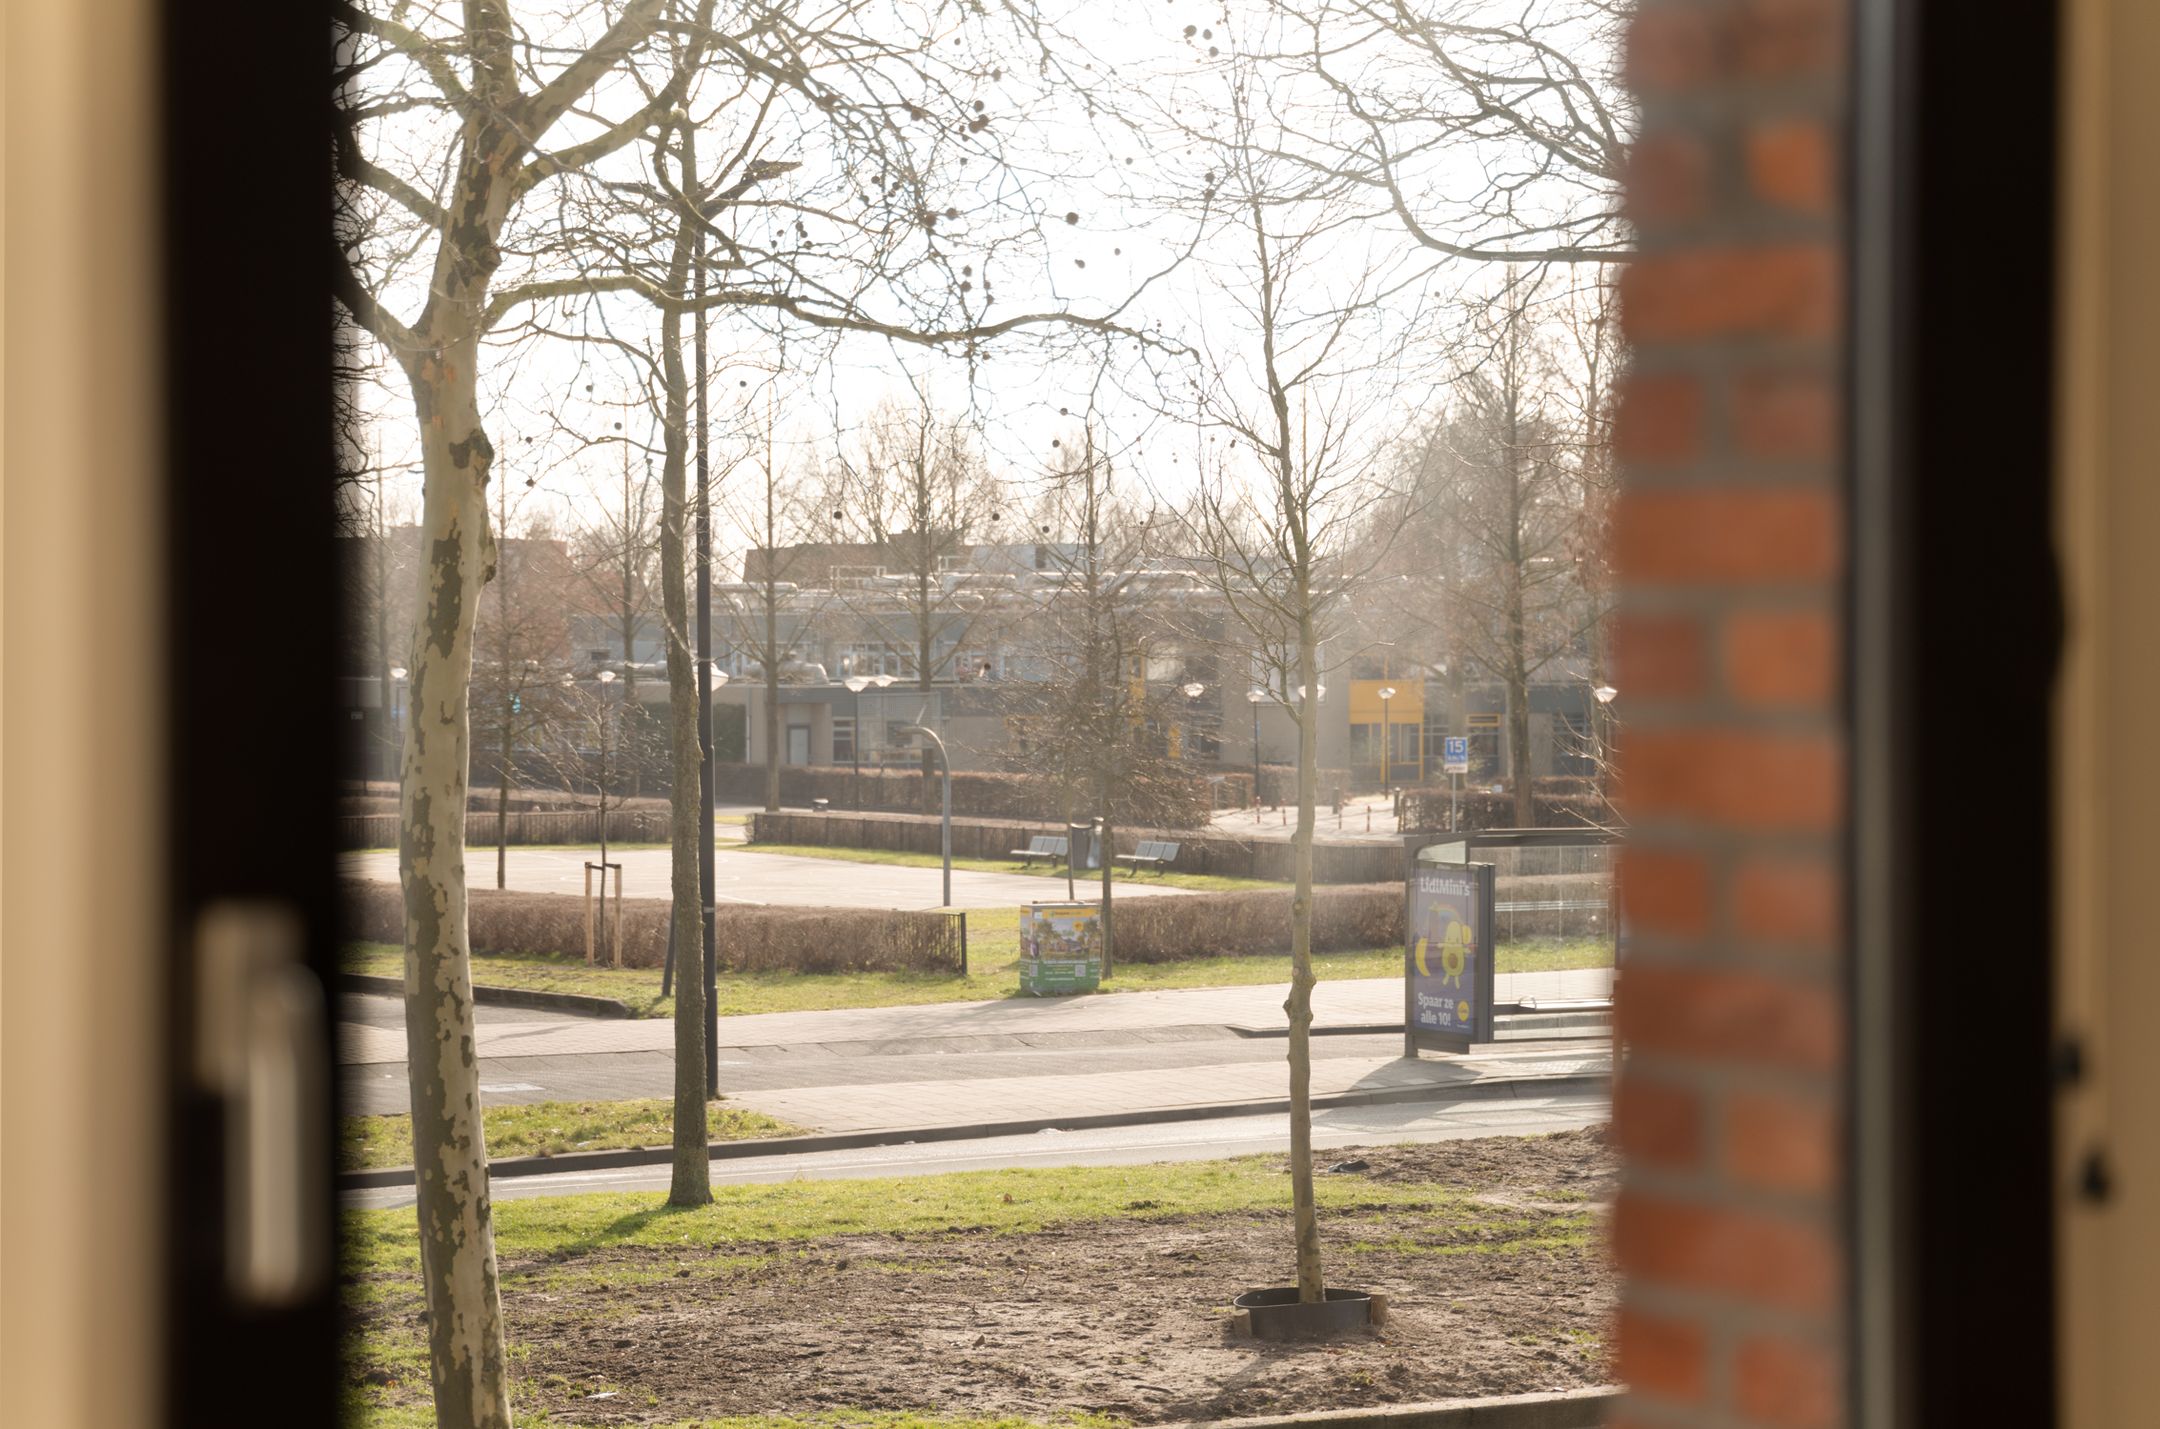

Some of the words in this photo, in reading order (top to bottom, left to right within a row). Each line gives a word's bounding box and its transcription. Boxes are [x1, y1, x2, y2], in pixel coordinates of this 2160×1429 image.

[1449, 740, 1464, 753] 15
[1417, 991, 1442, 1009] Spaar
[1443, 998, 1454, 1010] ze
[1420, 1009, 1437, 1024] alle
[1438, 1012, 1451, 1026] 10!
